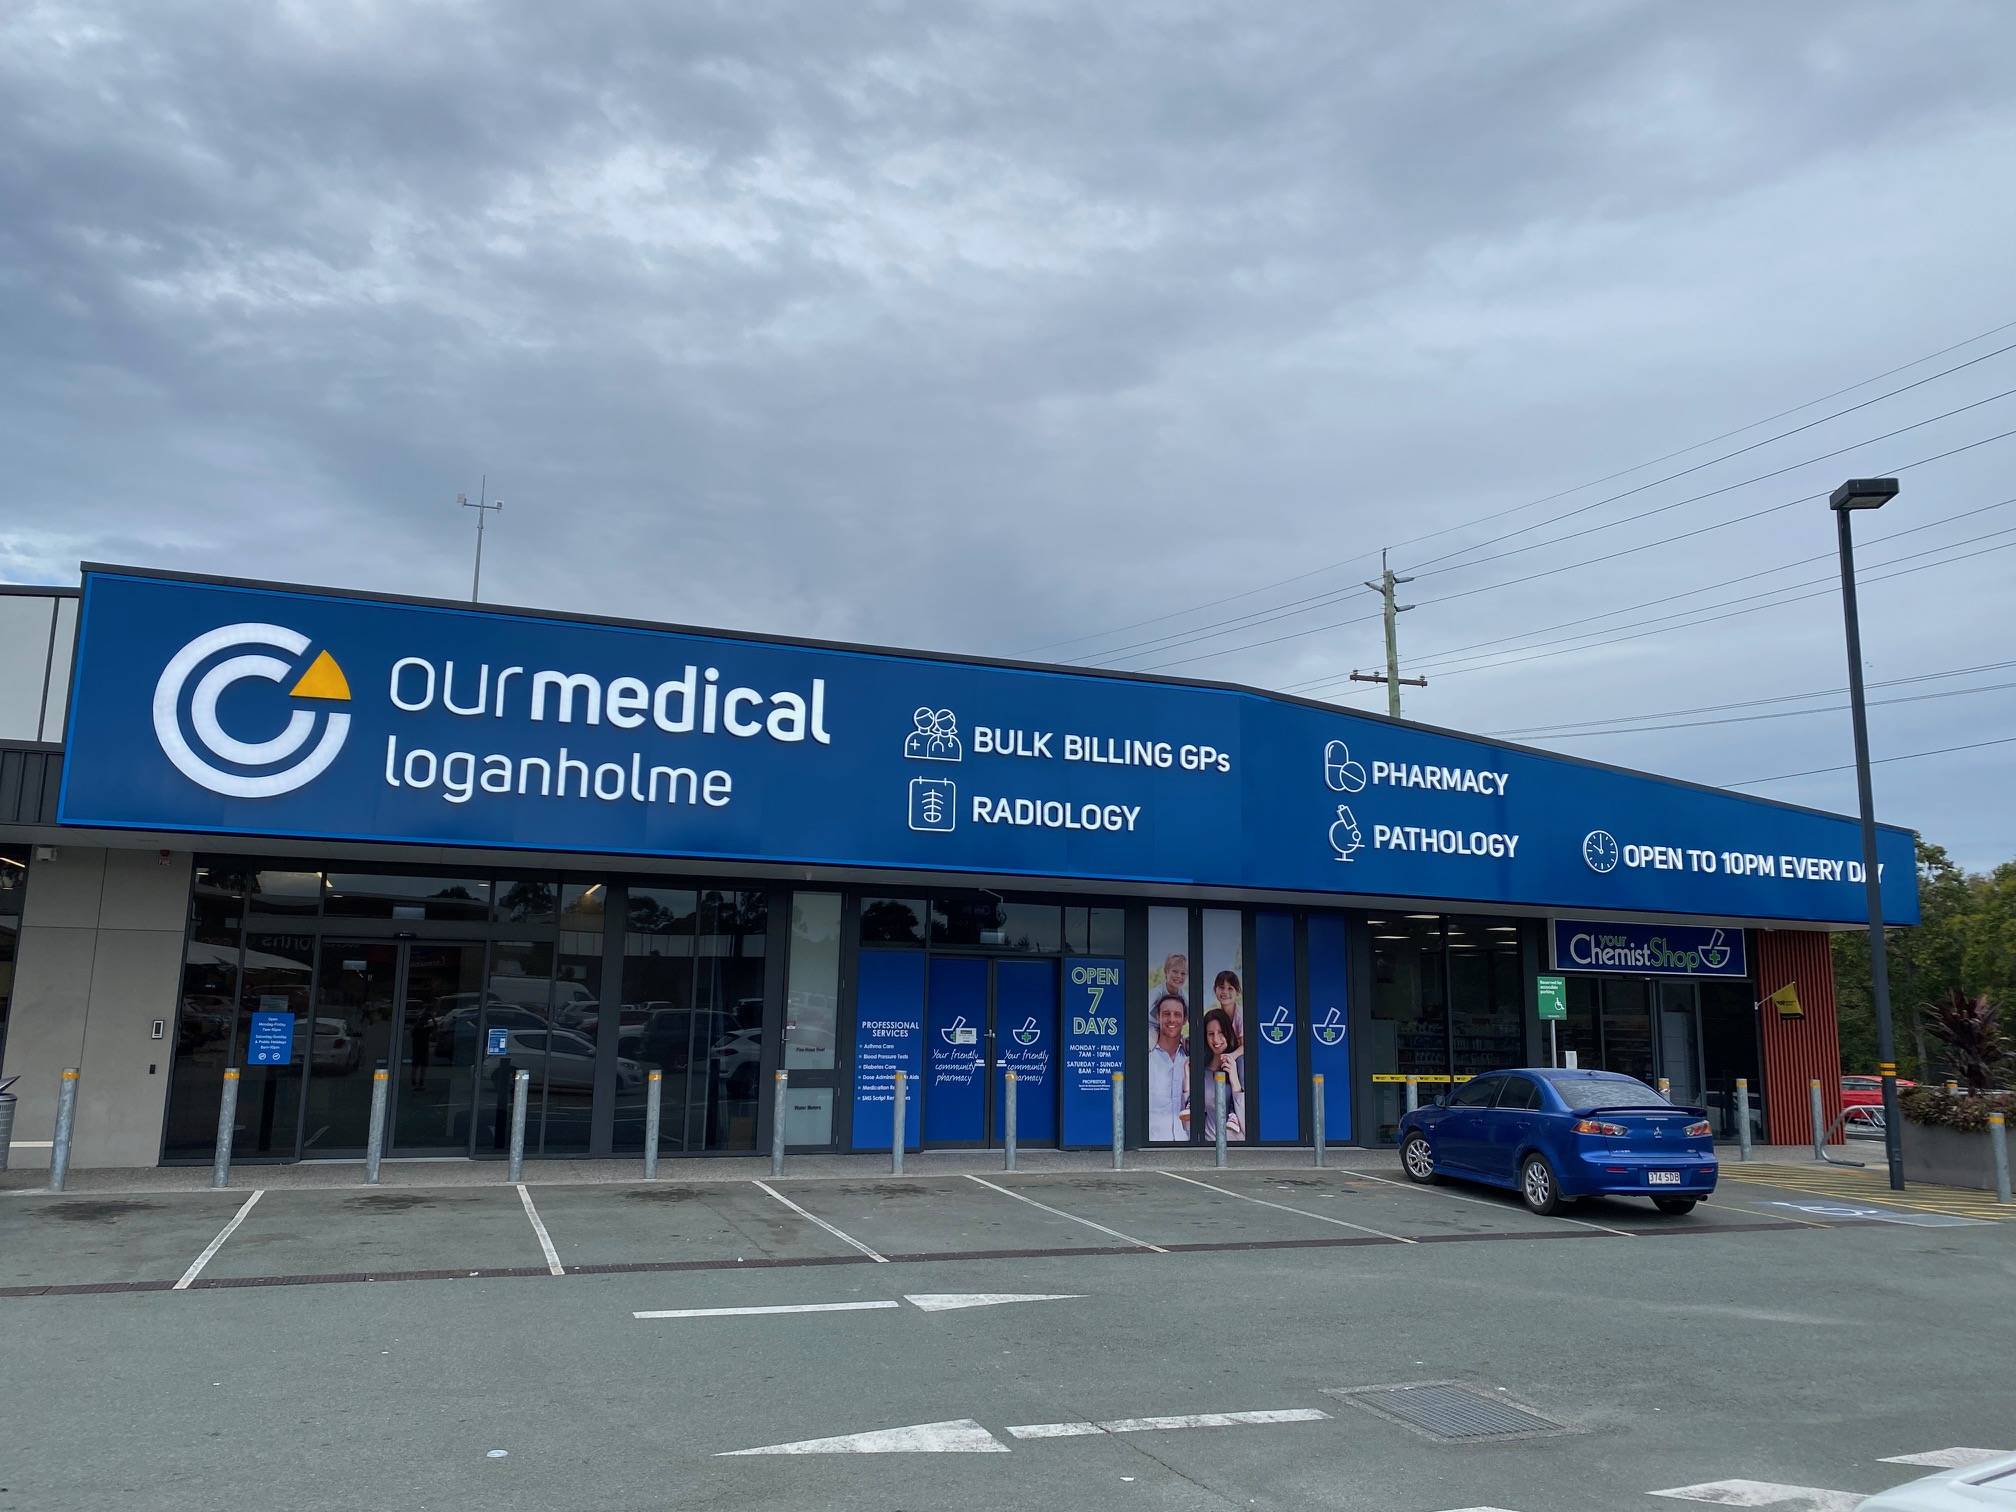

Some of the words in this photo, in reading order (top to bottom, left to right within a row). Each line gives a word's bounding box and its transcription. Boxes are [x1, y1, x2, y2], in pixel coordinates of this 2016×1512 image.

[974, 726, 1053, 758] BULK
[1064, 734, 1172, 768] BILLING
[1179, 745, 1231, 772] GPs
[386, 735, 732, 806] loganholme
[1372, 761, 1509, 796] PHARMACY
[972, 796, 1141, 831] RADIOLOGY
[1373, 824, 1519, 859] PATHOLOGY
[1623, 844, 1683, 871] OPEN
[1687, 849, 1716, 873] TO
[1721, 852, 1775, 877] 10PM
[1779, 856, 1843, 882] EVERY
[1600, 935, 1627, 948] your
[1072, 966, 1119, 985] OPEN
[1087, 987, 1104, 1014] 7
[862, 1021, 919, 1029] PROFESSIONAL
[872, 1029, 909, 1037] SERVICES
[1073, 1017, 1118, 1035] DAYS
[932, 1048, 949, 1059] Your
[1004, 1049, 1019, 1059] Your
[1022, 1049, 1049, 1064] friendly
[935, 1063, 976, 1074] community
[1007, 1063, 1047, 1074] community
[935, 1072, 972, 1086] pharmacy
[1016, 1074, 1043, 1085] armacy
